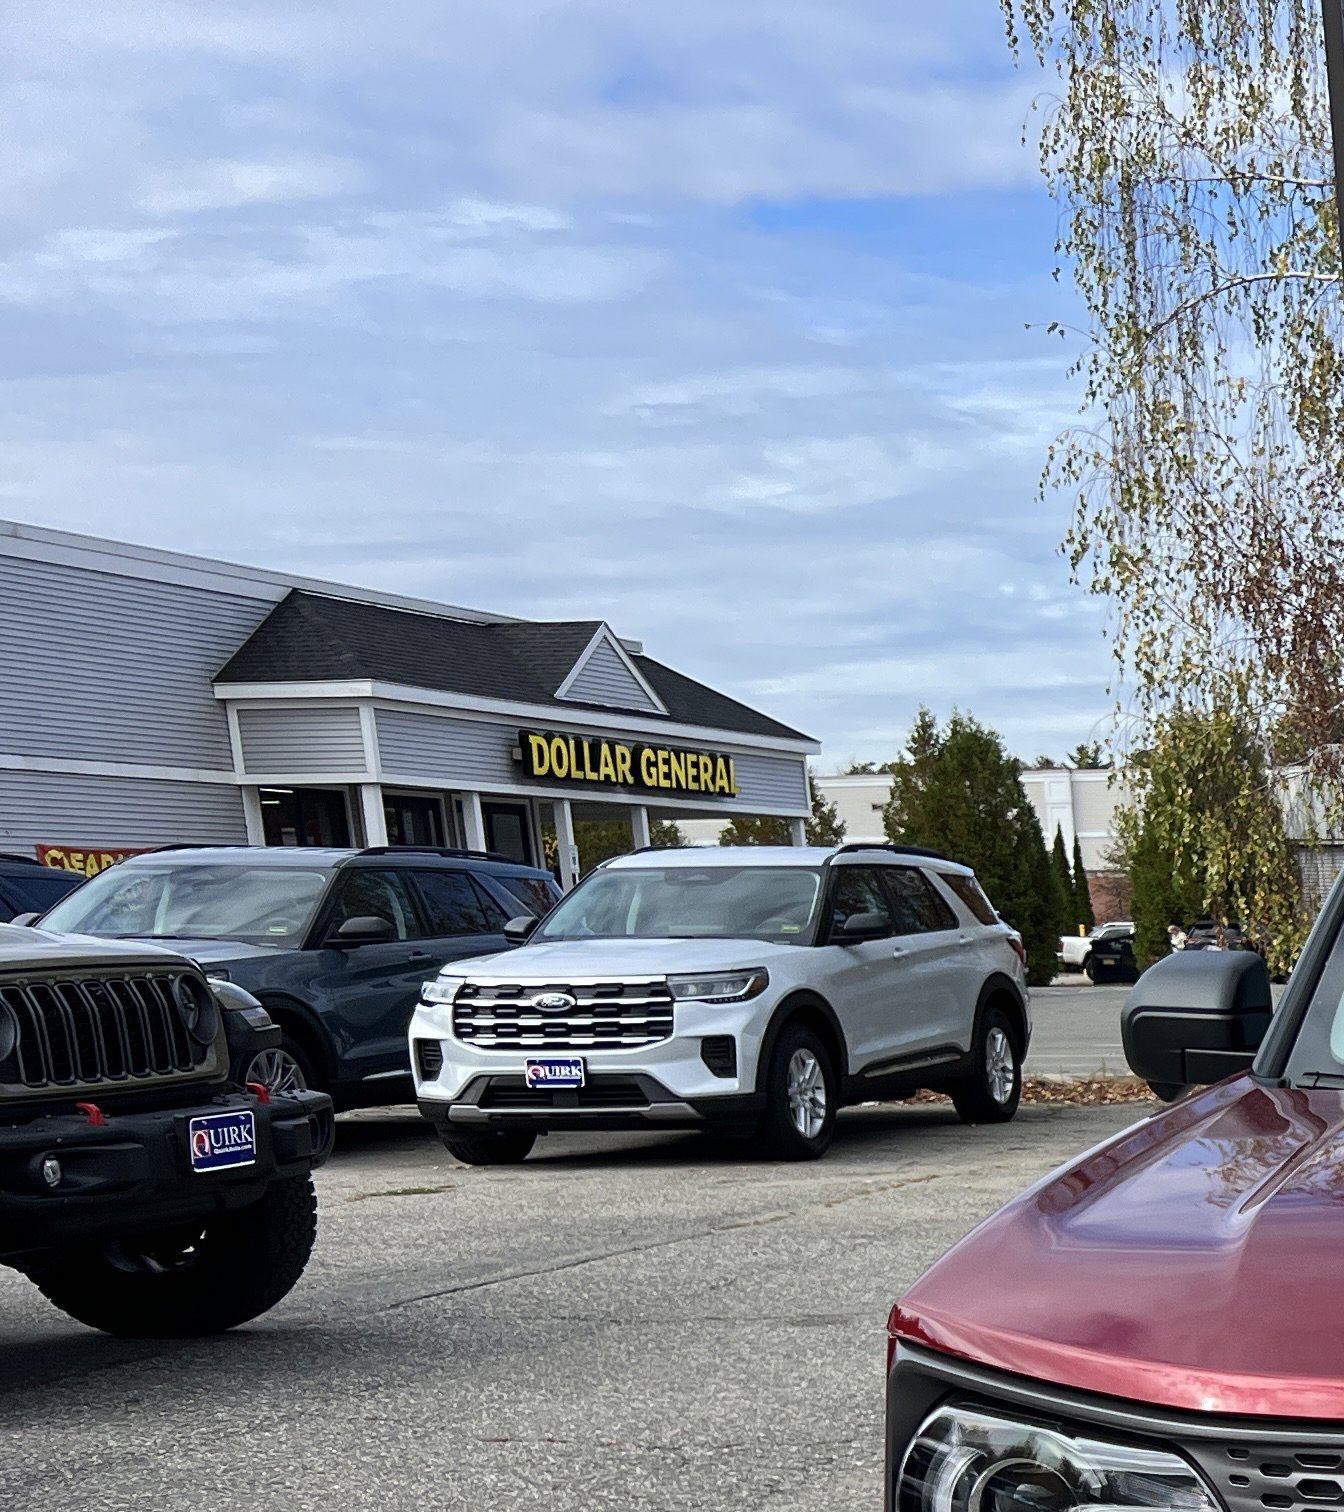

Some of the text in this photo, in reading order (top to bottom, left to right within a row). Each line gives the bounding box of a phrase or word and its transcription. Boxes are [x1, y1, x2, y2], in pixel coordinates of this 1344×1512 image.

[528, 734, 742, 794] DOLLAR GENERAL
[528, 1065, 582, 1080] QUIRK
[193, 1124, 254, 1158] QUIRK
